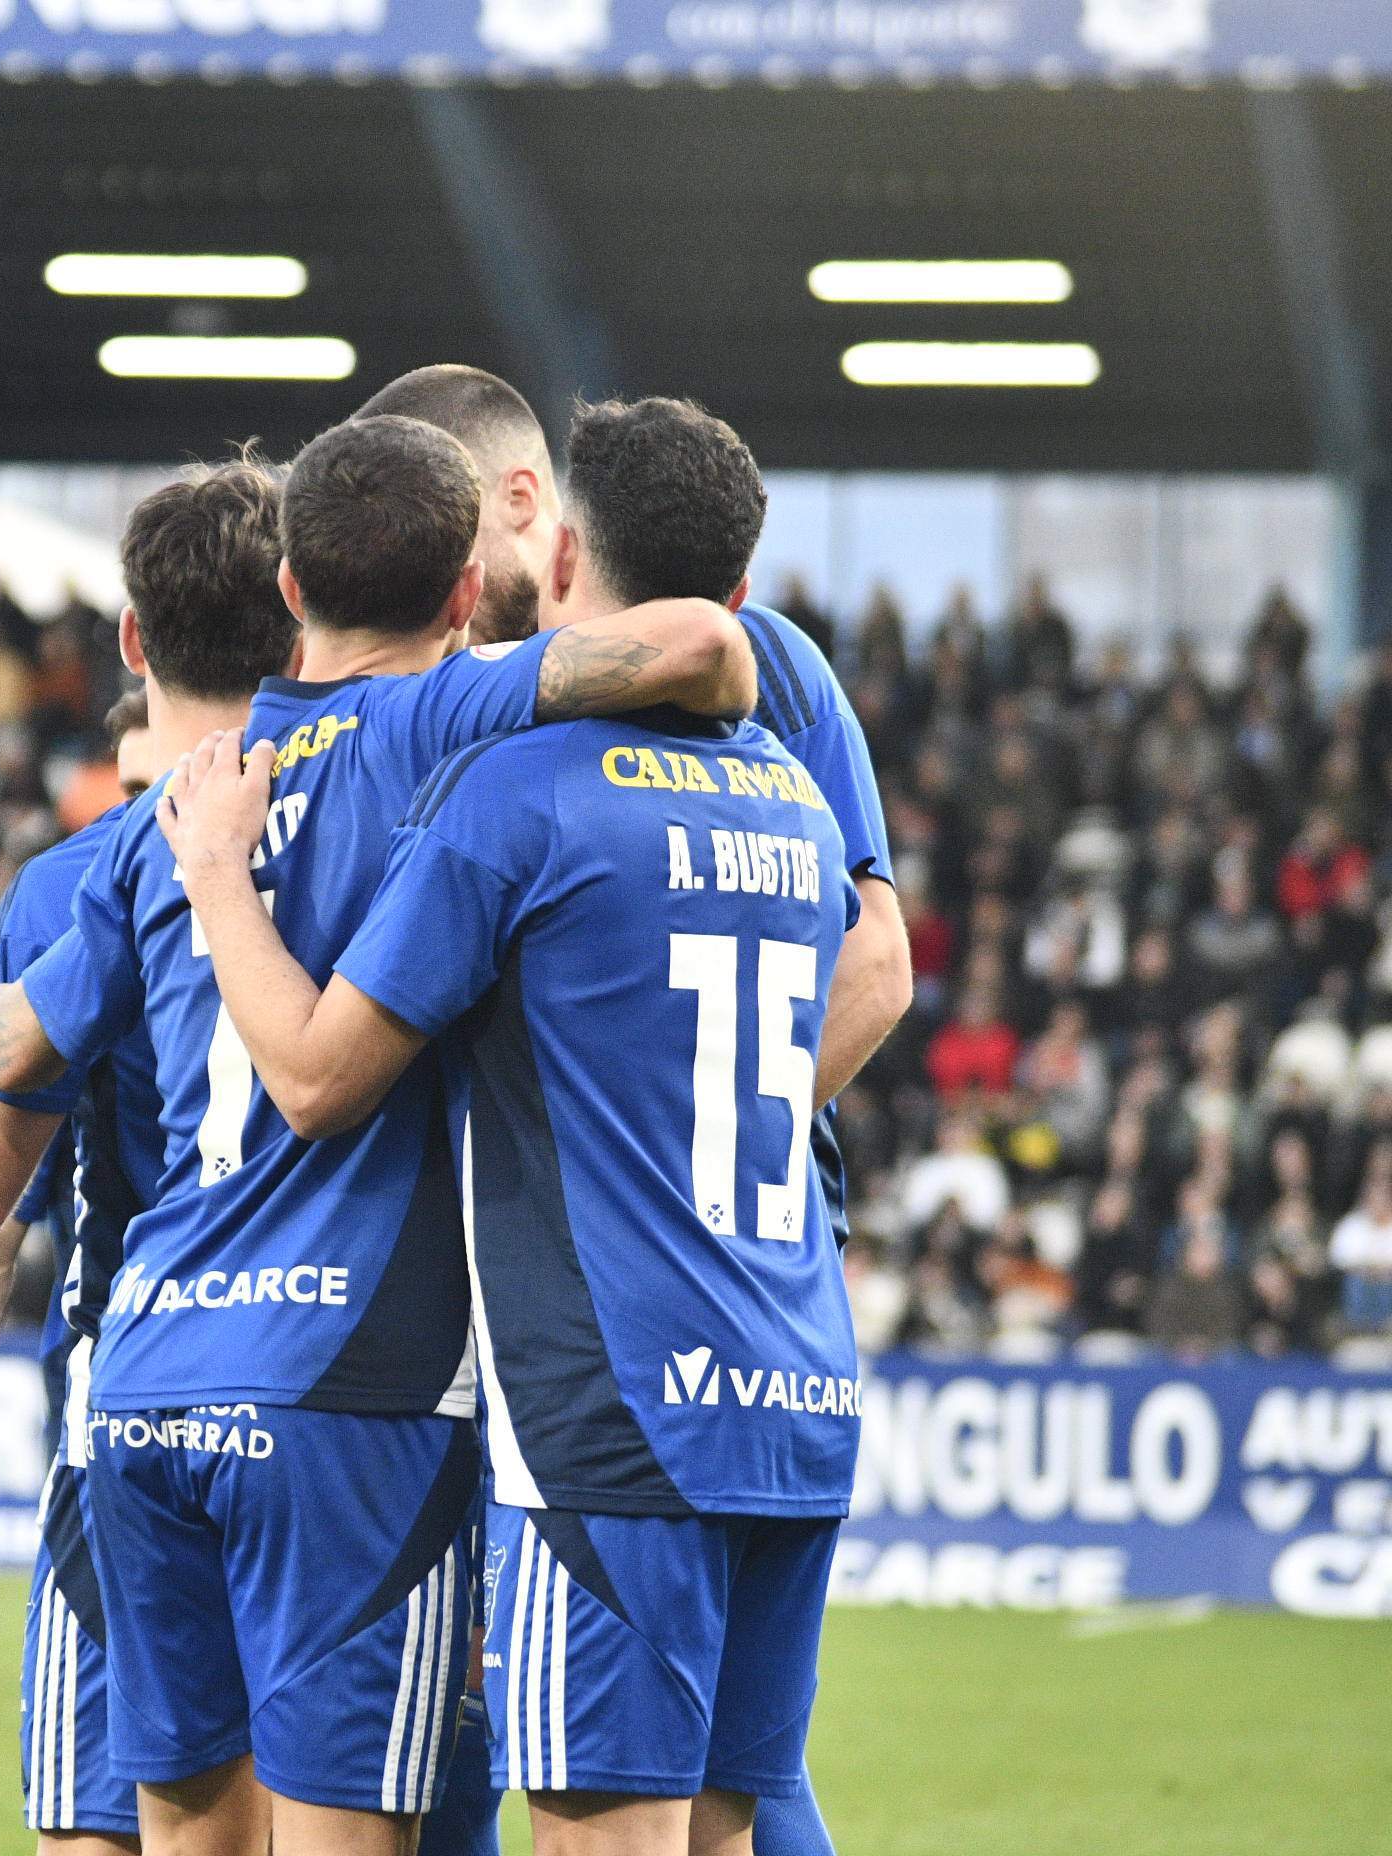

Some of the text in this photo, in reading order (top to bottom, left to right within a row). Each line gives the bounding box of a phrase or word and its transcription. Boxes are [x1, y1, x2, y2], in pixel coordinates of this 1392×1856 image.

[602, 746, 720, 792] CAJA
[666, 825, 820, 904] A. BUSTOS
[668, 932, 817, 1243] 15
